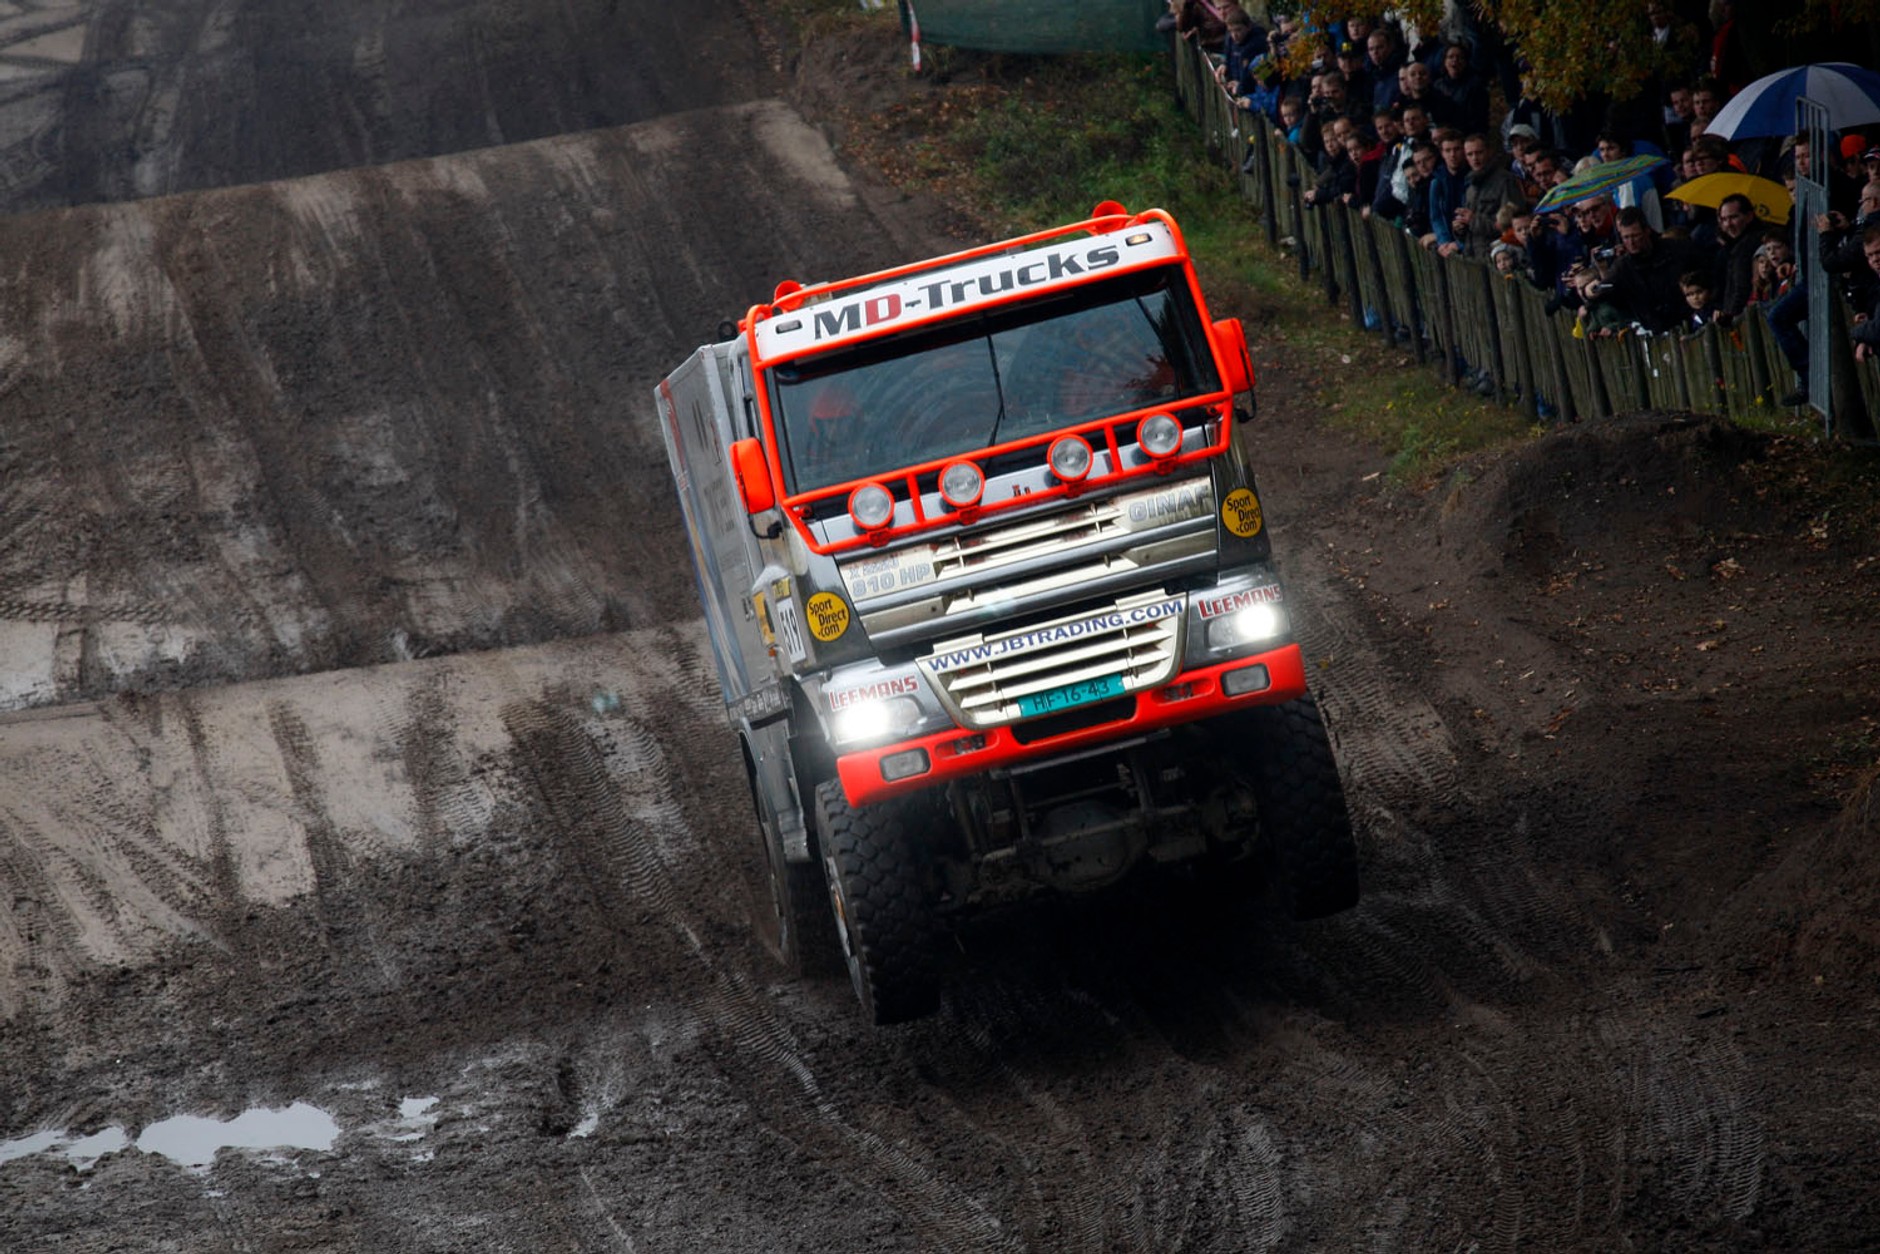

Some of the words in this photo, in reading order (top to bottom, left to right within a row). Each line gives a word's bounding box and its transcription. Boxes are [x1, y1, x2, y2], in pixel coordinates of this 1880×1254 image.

[814, 245, 1120, 341] MD-Trucks
[852, 572, 895, 598] 810
[900, 562, 931, 586] HP
[809, 598, 833, 617] Sport
[818, 608, 846, 627] Direct
[1198, 583, 1283, 620] LEEMANS
[818, 624, 840, 638] .com
[928, 600, 1183, 672] WWW.JBTRADING.COM
[829, 675, 919, 712] LEEMANS
